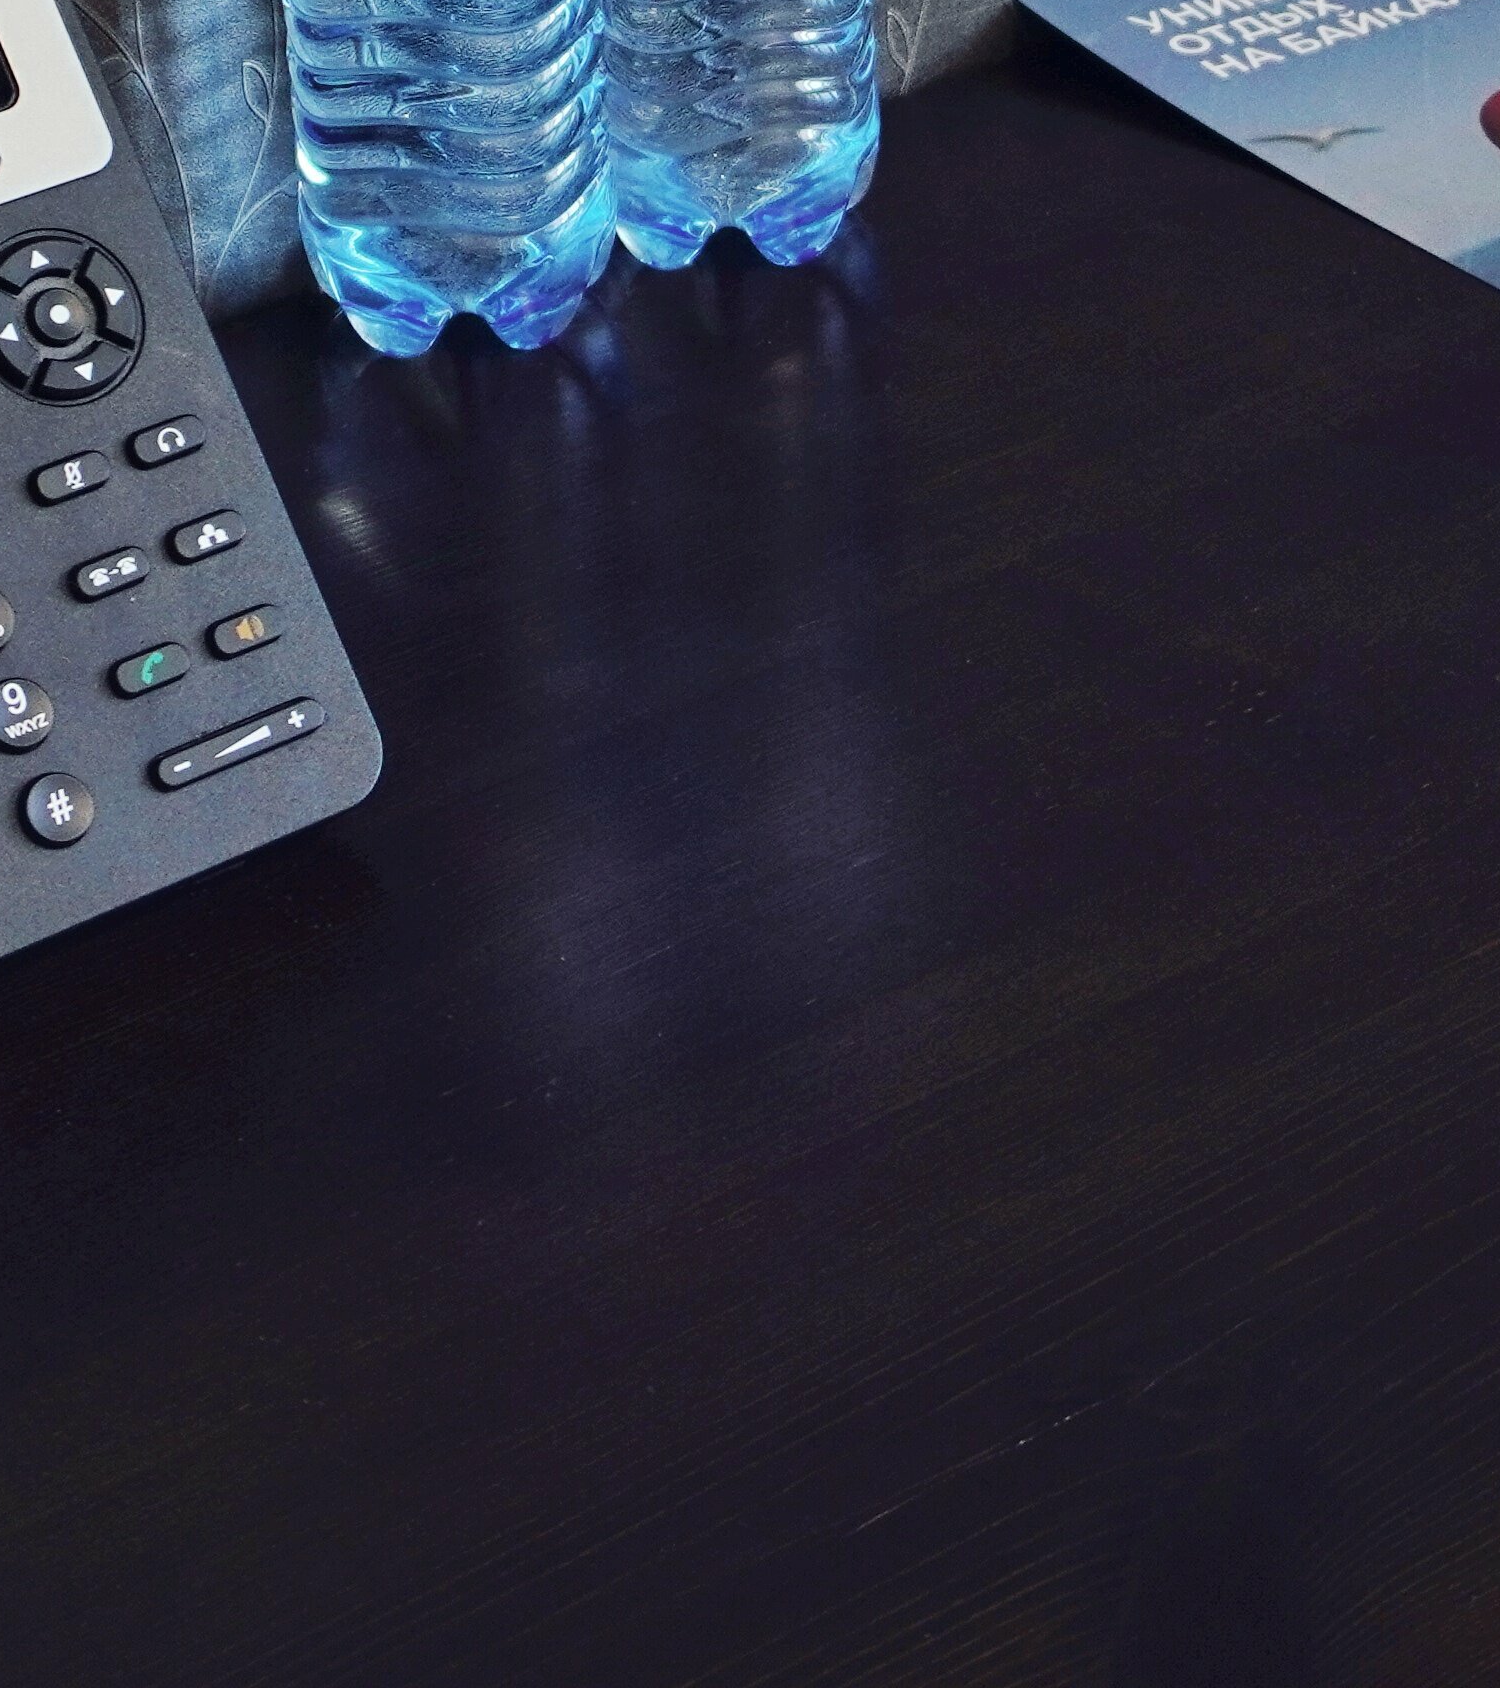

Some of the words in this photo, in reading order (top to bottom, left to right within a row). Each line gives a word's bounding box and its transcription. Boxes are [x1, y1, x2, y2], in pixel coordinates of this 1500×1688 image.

[1200, 46, 1285, 80] НА
[2, 682, 27, 714] 9
[4, 713, 49, 739] WXYZ
